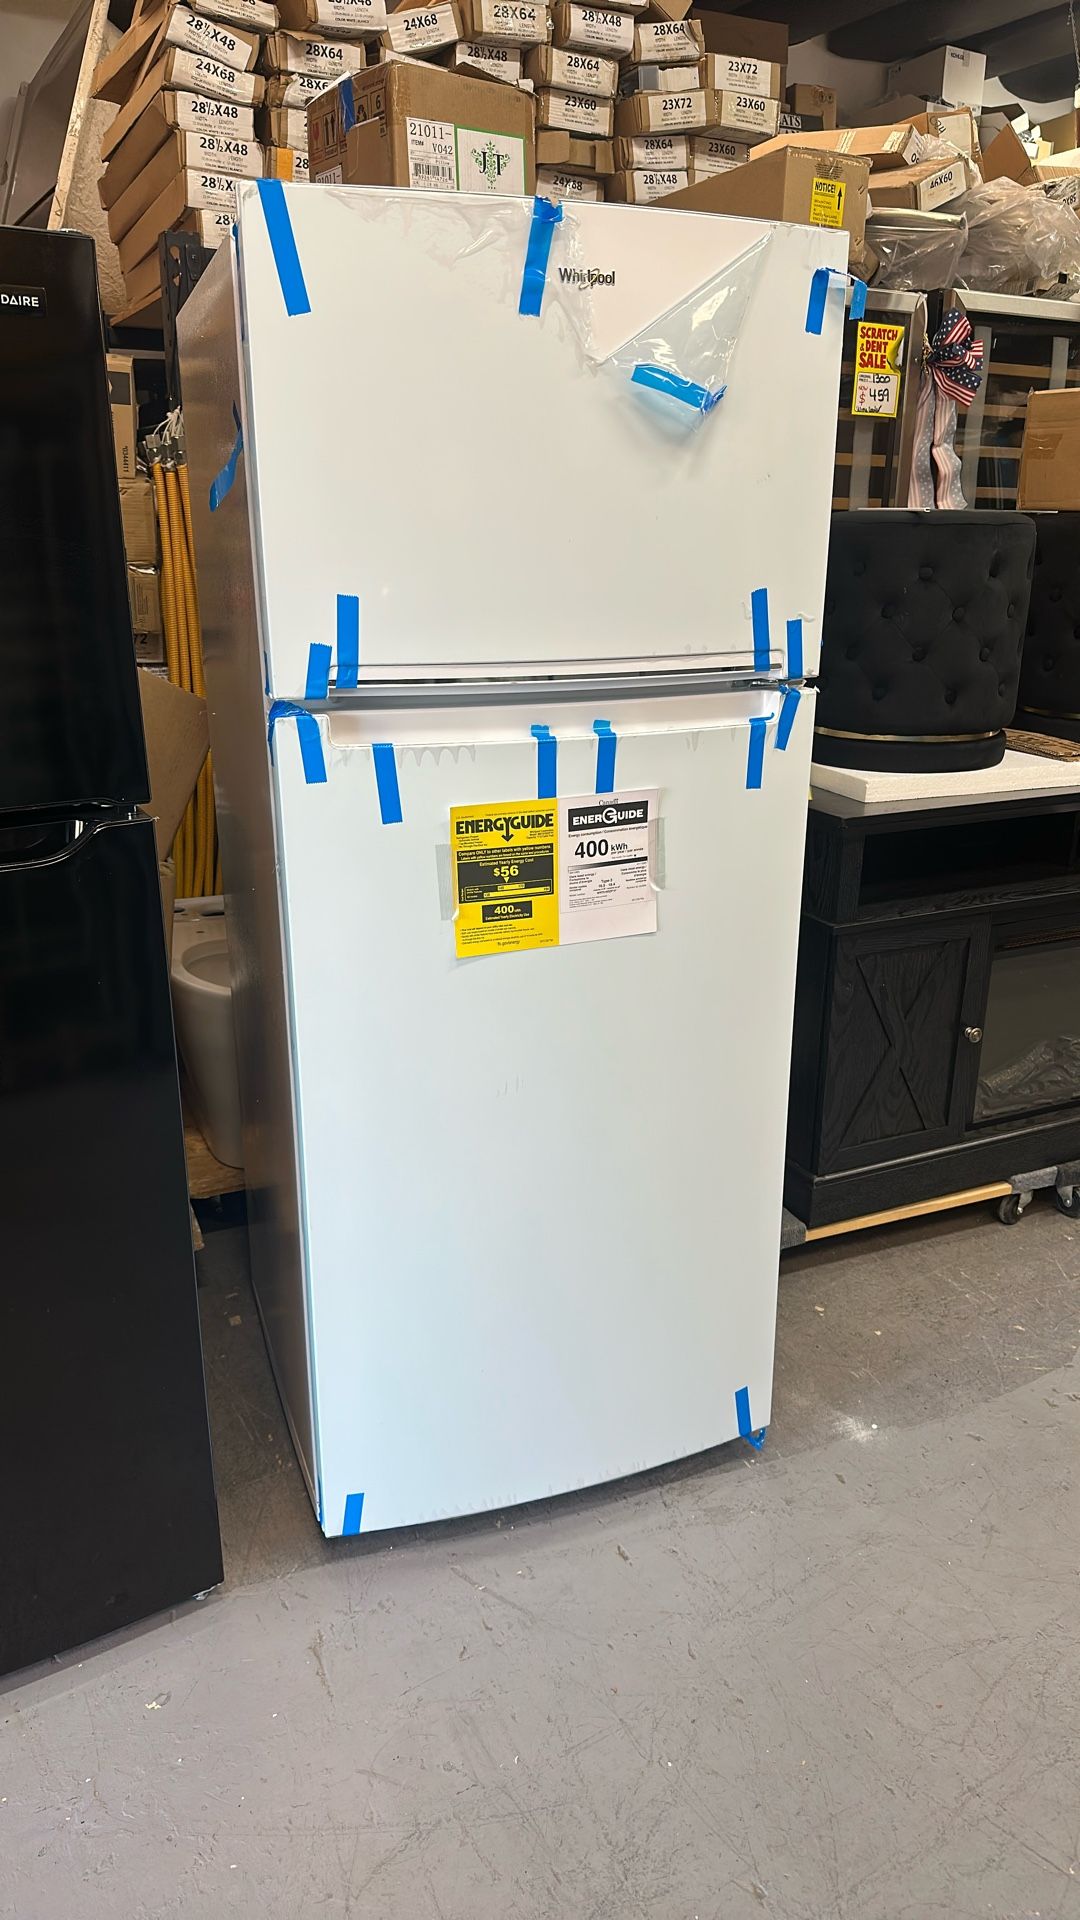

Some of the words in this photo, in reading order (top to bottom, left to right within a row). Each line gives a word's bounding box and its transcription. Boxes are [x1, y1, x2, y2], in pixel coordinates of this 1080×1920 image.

[493, 4, 536, 21] 28X64
[403, 13, 438, 31] 24X68
[652, 22, 685, 36] 28X64
[305, 43, 344, 60] 28X64
[195, 58, 236, 84] 24X68
[567, 56, 600, 72] 28X64
[728, 60, 758, 75] 23X72
[564, 95, 597, 111] 23X60
[662, 98, 692, 110] 23X72
[736, 96, 766, 112] 23X60
[780, 114, 801, 127] ATS
[410, 122, 452, 140] 21011-
[432, 143, 453, 155] V042
[644, 138, 673, 150] 28X64
[708, 142, 736, 156] 23X60
[201, 175, 236, 192] 28½X
[552, 176, 584, 192] 24X68
[814, 181, 836, 194] NOTICE!
[558, 268, 616, 289] Whirlpool
[0, 294, 40, 308] DAIRE
[860, 326, 898, 340] SCRATCH
[860, 342, 865, 352] &
[865, 340, 888, 354] DENT
[859, 352, 887, 369] SALE
[456, 813, 554, 835] ENERGYGUIDE
[572, 807, 644, 826] ENERGUIDE
[574, 838, 609, 858] 400
[610, 842, 628, 852] kWh
[493, 865, 519, 877] $56
[494, 904, 514, 914] 400
